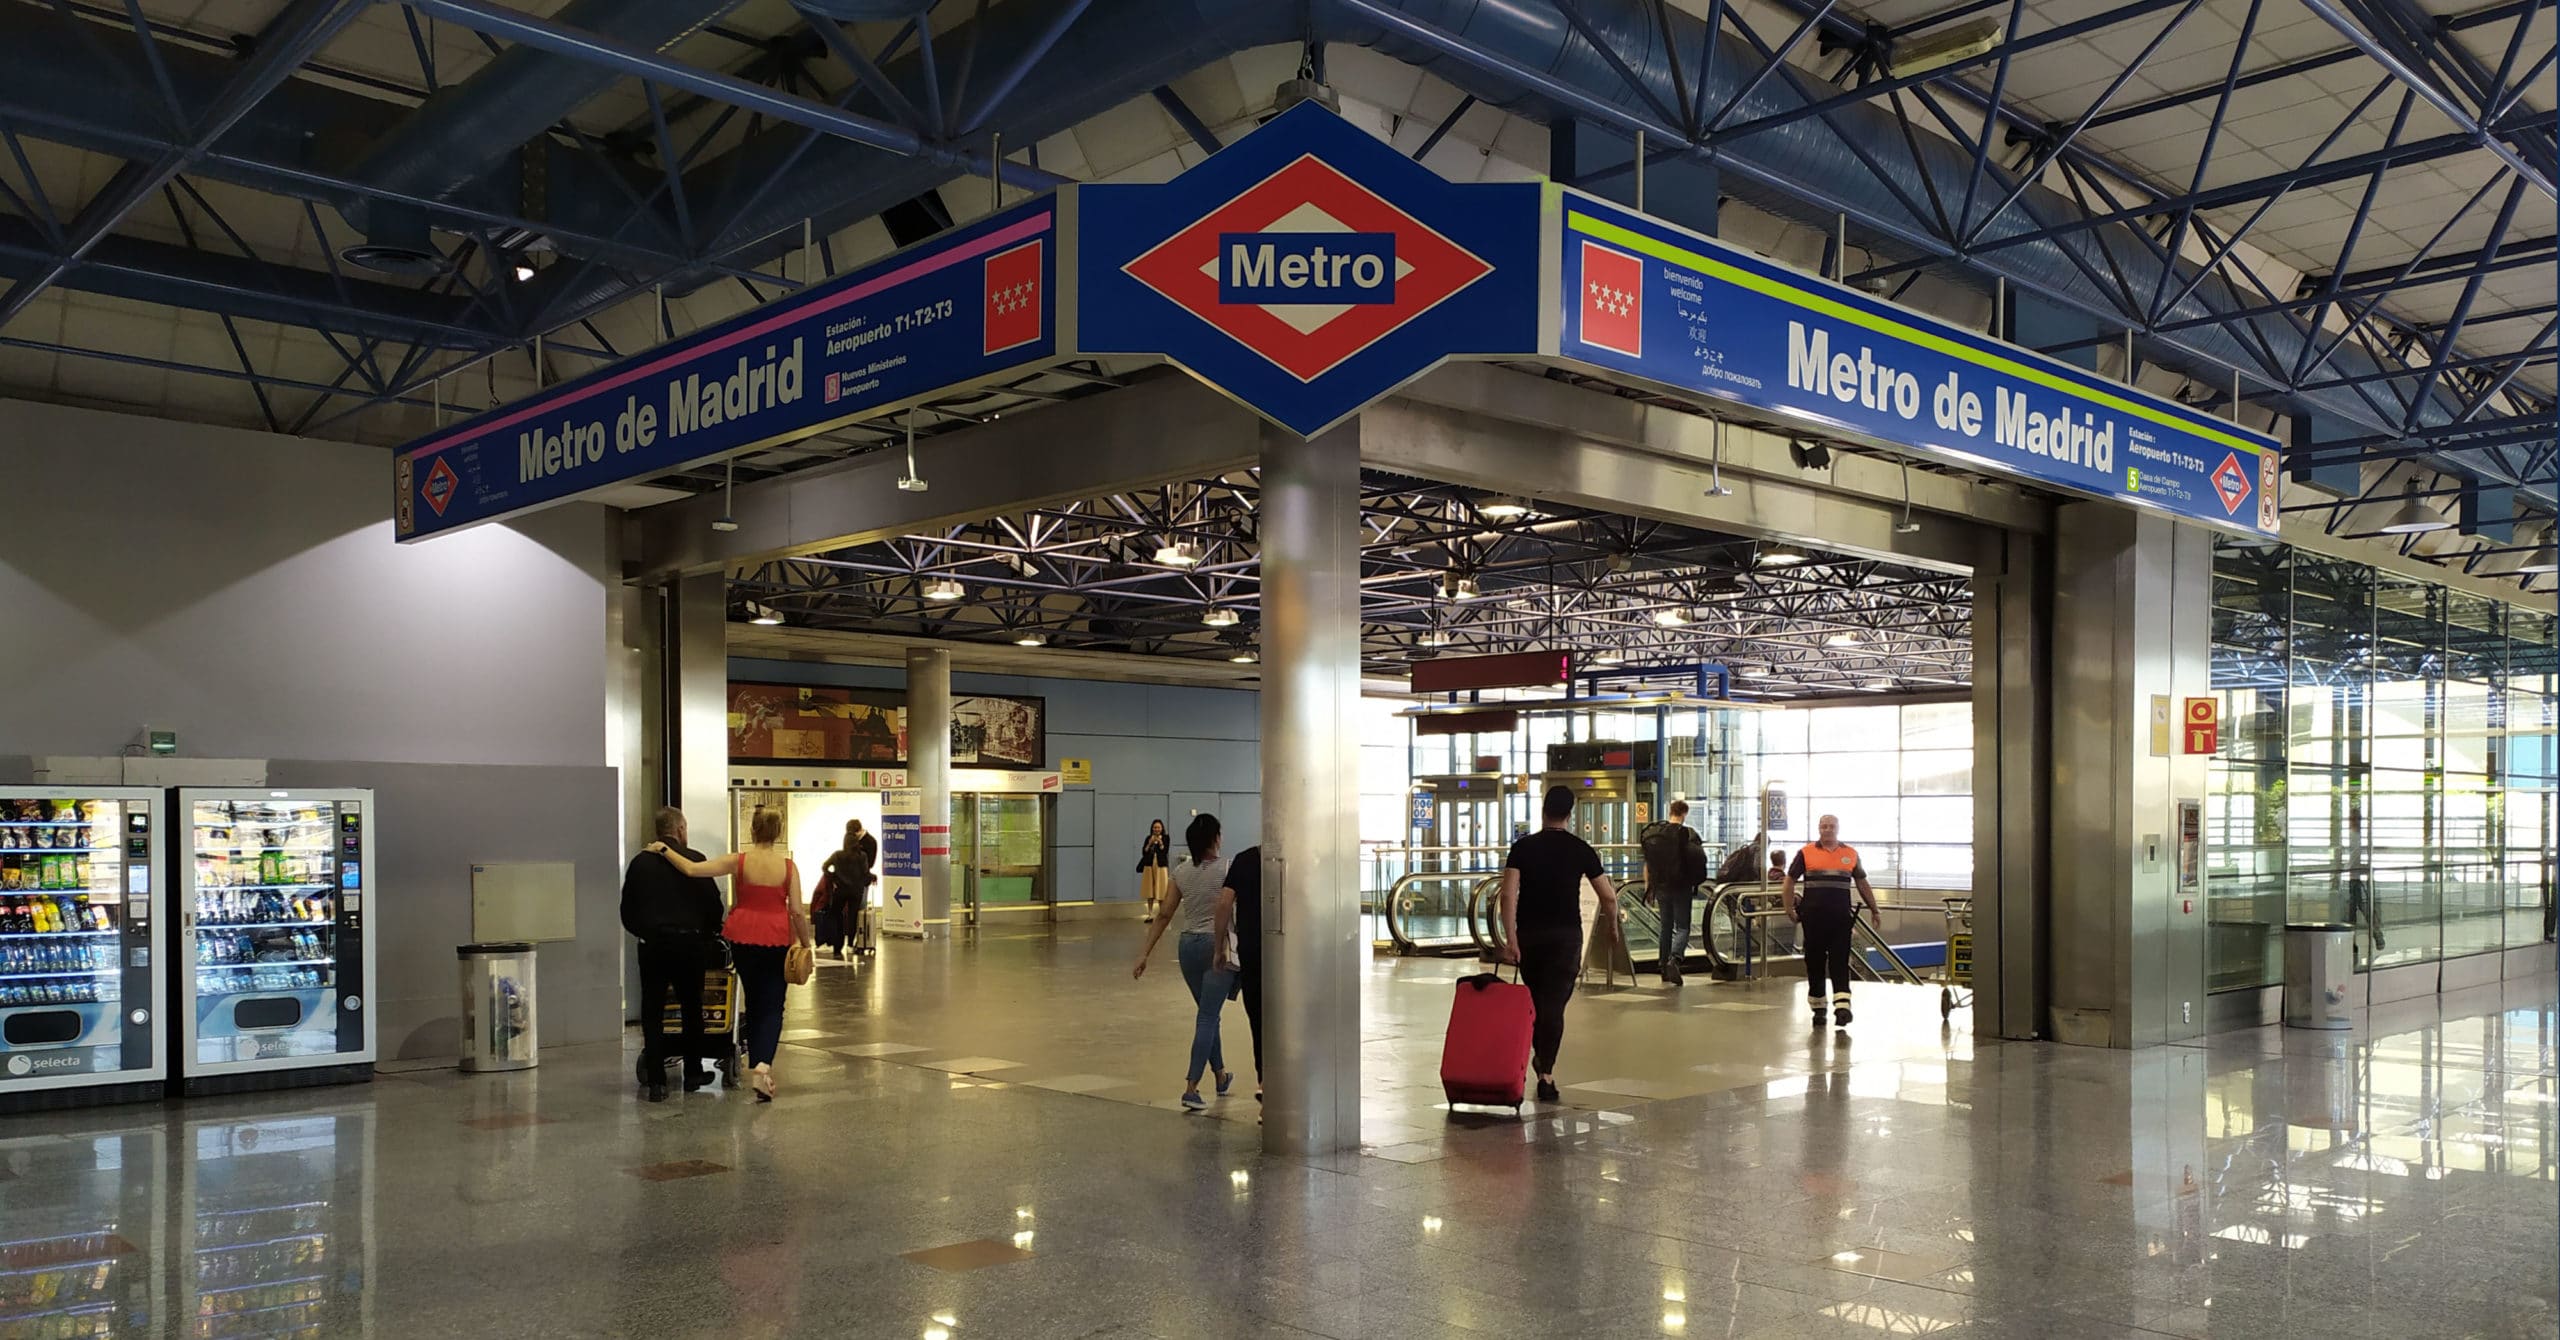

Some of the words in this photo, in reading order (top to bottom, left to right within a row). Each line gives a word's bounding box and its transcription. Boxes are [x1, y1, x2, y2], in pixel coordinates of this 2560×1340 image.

[1231, 244, 1385, 289] Metro
[1663, 266, 1704, 290] bienvenido
[1670, 286, 1702, 304] welcome
[826, 317, 862, 338] Estación
[826, 323, 892, 357] Aeropuerto
[895, 299, 953, 333] T1-T2-T3
[1694, 345, 1724, 364] ようこそ
[841, 367, 867, 382] Nuevos
[867, 355, 907, 374] Ministerios
[1702, 363, 1723, 380] добро
[1724, 370, 1763, 389] пожаловать
[828, 377, 837, 398] 8
[841, 379, 880, 397] Aeropuerto
[1787, 319, 1921, 421] Metro
[1933, 370, 1983, 438] de
[1994, 384, 2115, 474] Madrid
[519, 420, 606, 484] Metro
[615, 395, 658, 454] de
[668, 336, 804, 439] Madrid
[2128, 439, 2171, 464] Aeropuerto
[2172, 451, 2205, 473] T1-T2-T3
[2129, 471, 2136, 488] 5
[2222, 475, 2240, 492] Metro
[33, 1056, 81, 1069] selecta
